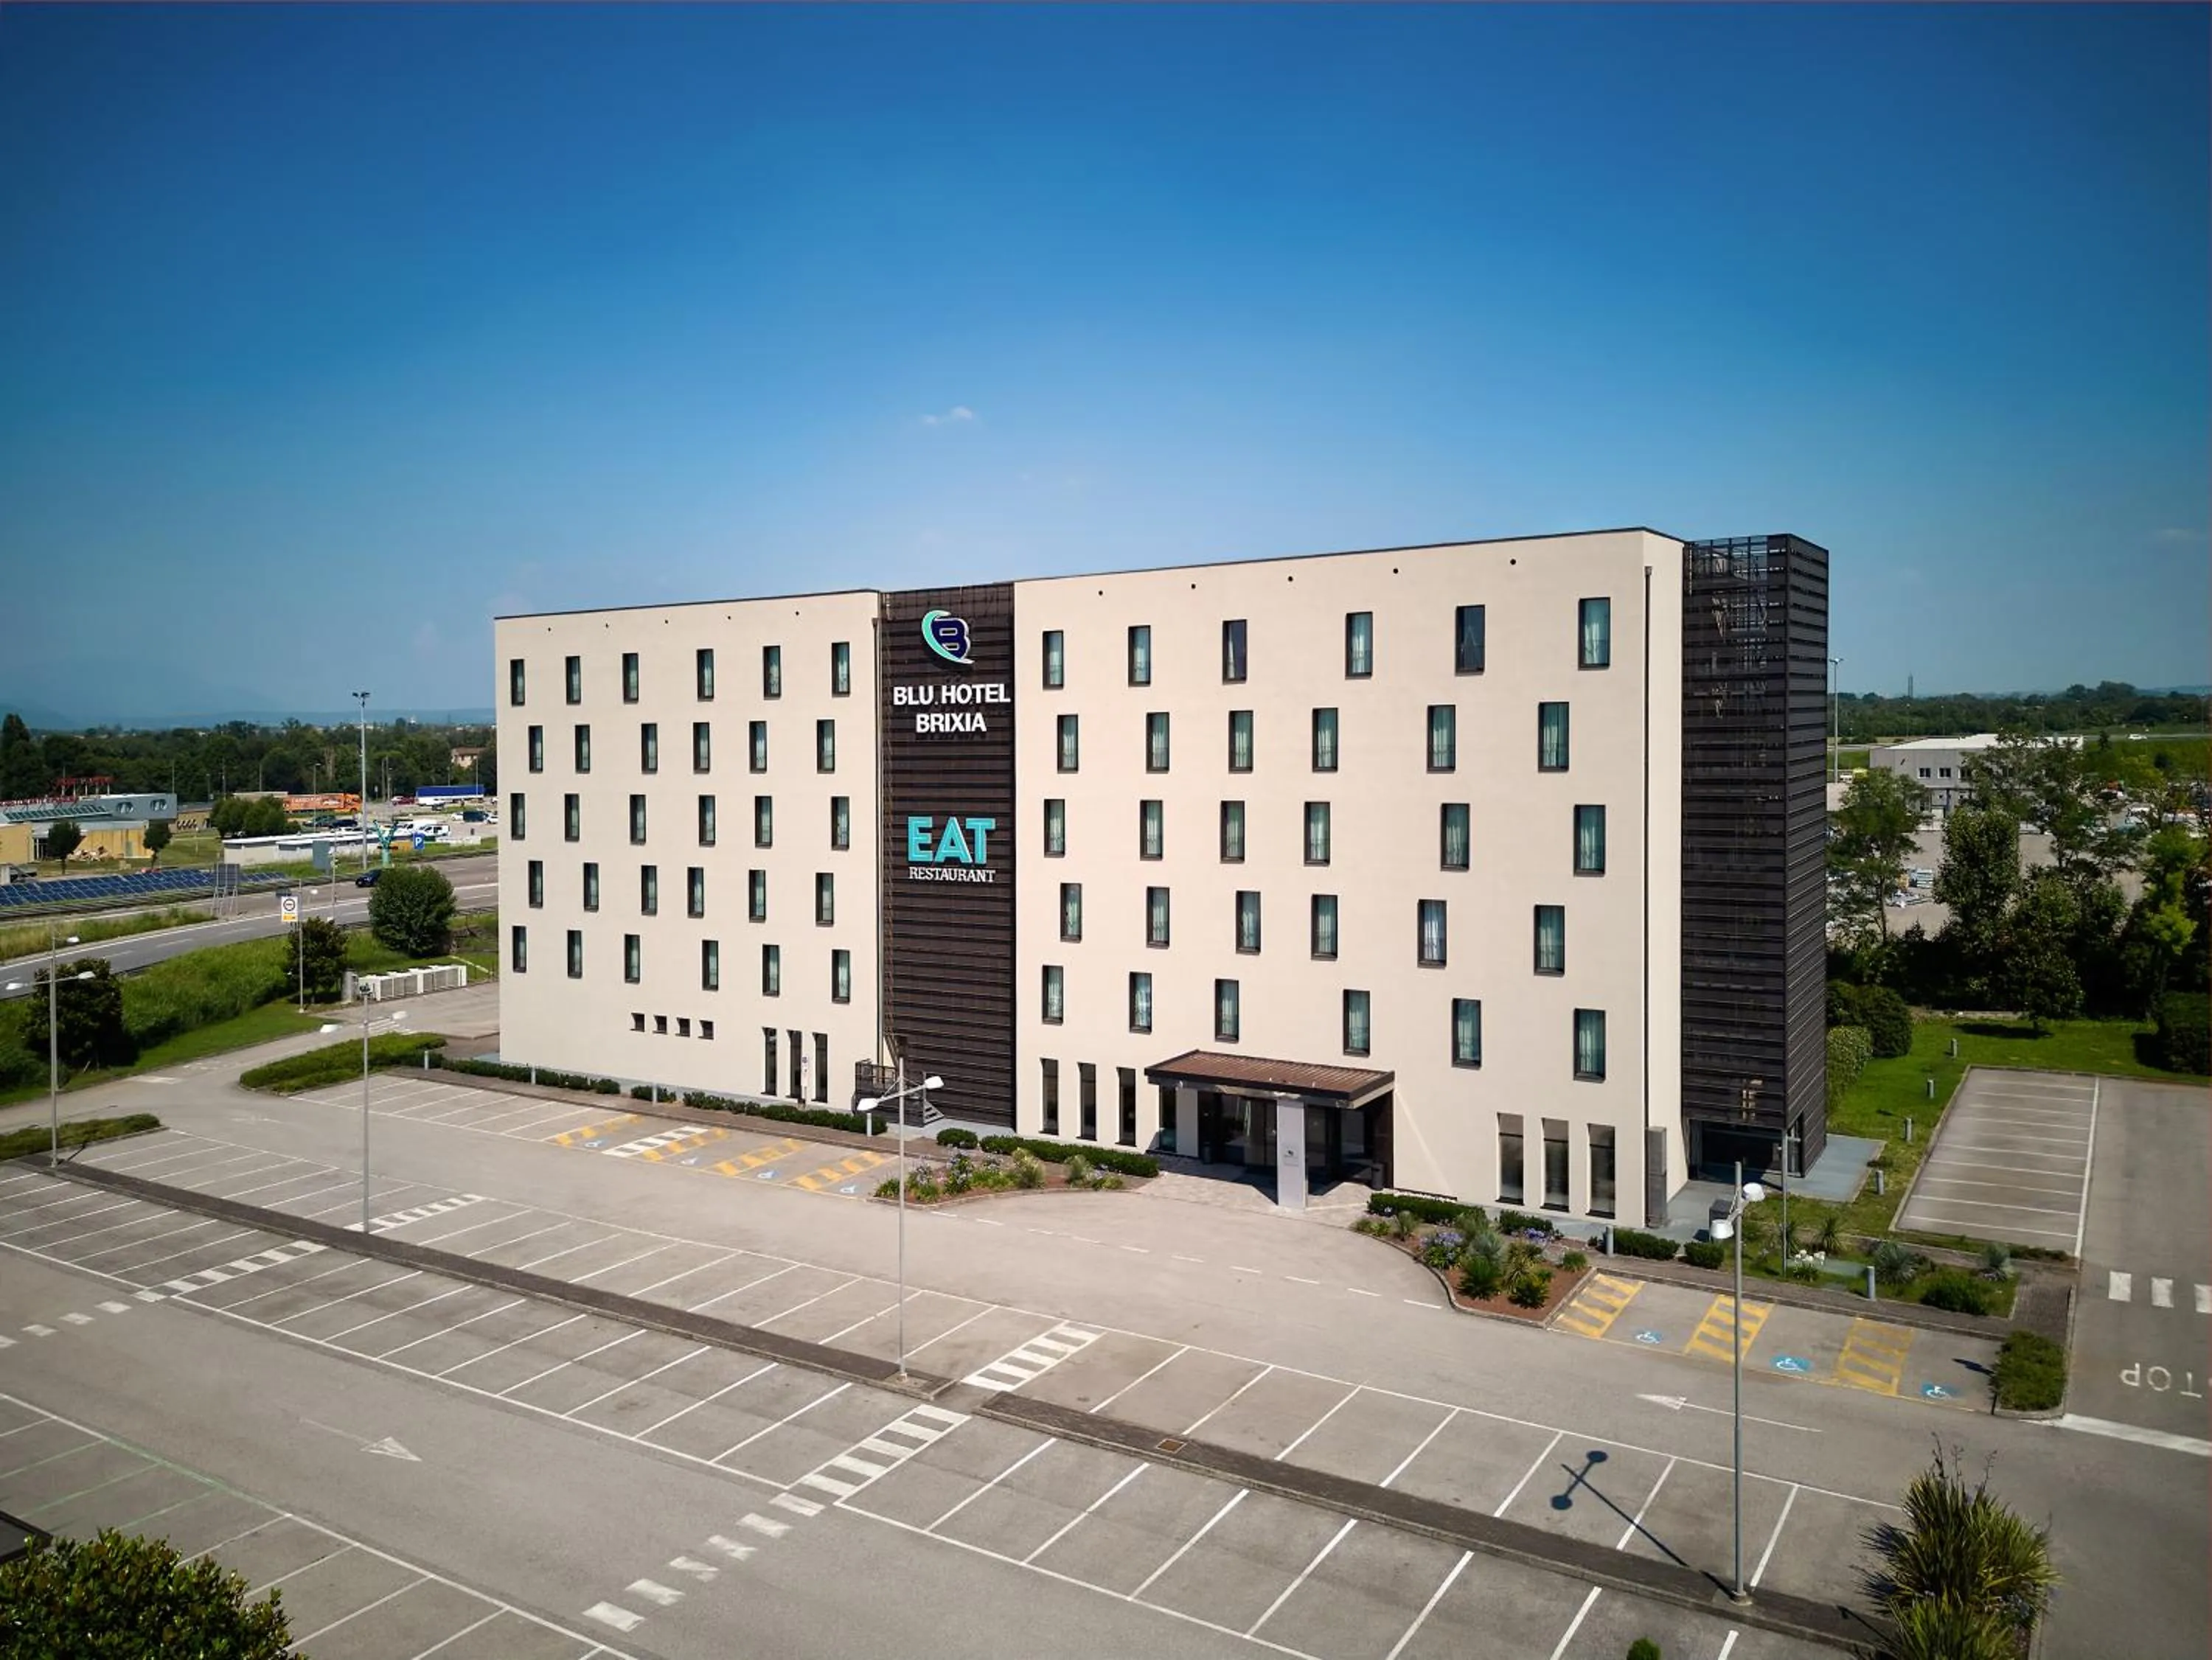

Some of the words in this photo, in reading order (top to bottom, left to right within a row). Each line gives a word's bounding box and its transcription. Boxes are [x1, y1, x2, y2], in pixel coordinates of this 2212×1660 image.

[894, 686, 933, 705] BLU
[942, 684, 1011, 704] HOTEL
[916, 712, 987, 733] BRIXIA
[415, 837, 422, 847] P
[908, 816, 996, 865] EAT
[909, 866, 996, 882] RESTAURANT
[2119, 1362, 2212, 1398] TOP
